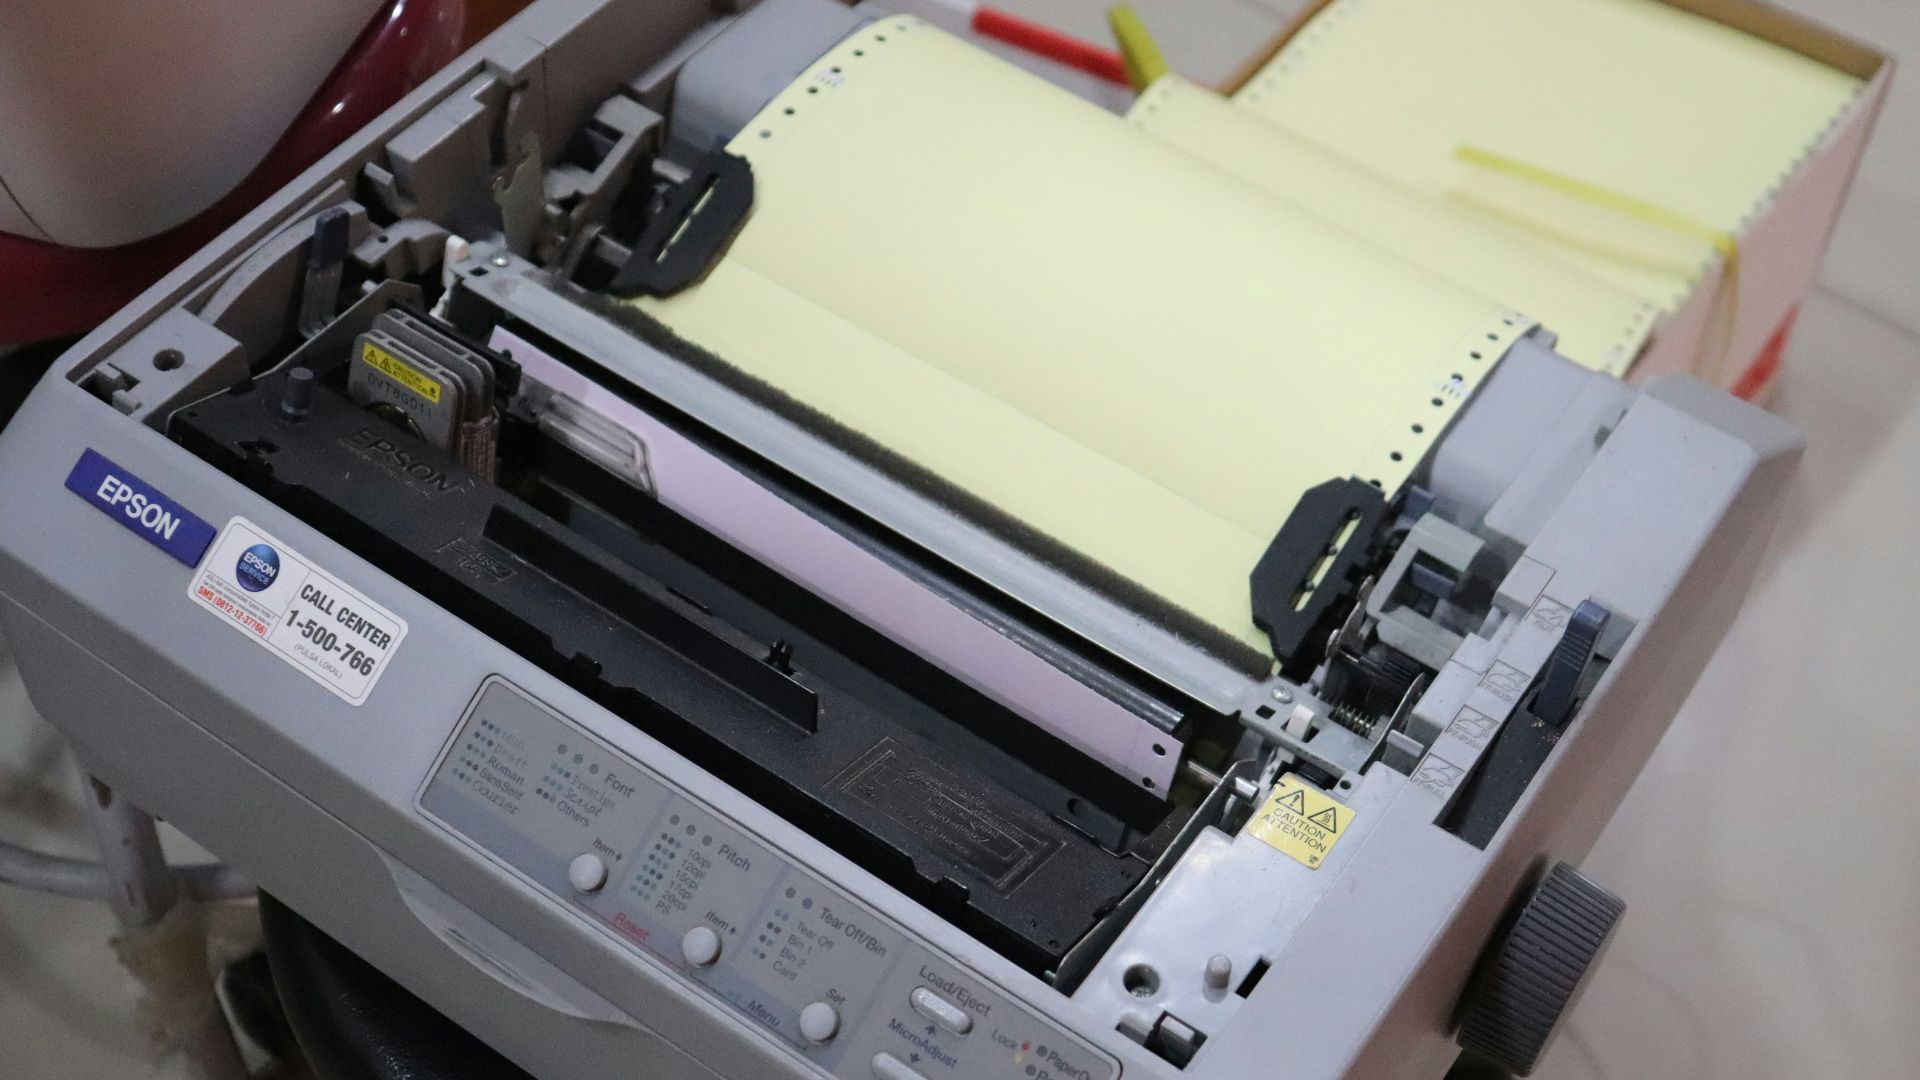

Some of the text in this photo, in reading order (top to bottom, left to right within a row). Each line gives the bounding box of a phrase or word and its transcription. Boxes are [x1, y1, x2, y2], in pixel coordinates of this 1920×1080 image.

[96, 474, 181, 541] EPSON
[238, 561, 271, 586] SERVICE
[243, 551, 277, 578] EPSON
[197, 585, 214, 601] SMS
[213, 598, 268, 637] (0812-12-37766)
[300, 584, 335, 617] CALL
[336, 607, 391, 651] CENTER
[286, 609, 376, 677] 1-500-766
[295, 643, 343, 679] (PULSA LOKAL)
[487, 754, 524, 785] Roman
[472, 780, 518, 815] Courier
[604, 772, 636, 799] Font
[557, 800, 590, 828] Others
[1273, 807, 1326, 841] CAUTION
[1261, 813, 1327, 853] ATTENTION
[717, 843, 751, 873] Pitch
[614, 911, 650, 941] Reset
[705, 911, 729, 930] Item
[819, 906, 887, 958] Tear Off/Bin
[786, 933, 805, 950] Bin
[797, 921, 835, 951] Tear Off
[779, 946, 797, 963] Bin
[772, 960, 798, 981] Card
[826, 988, 846, 1005] Set
[918, 963, 992, 1017] Load/Eject
[747, 1000, 780, 1027] Menu
[887, 1018, 958, 1069] MicroAdjust
